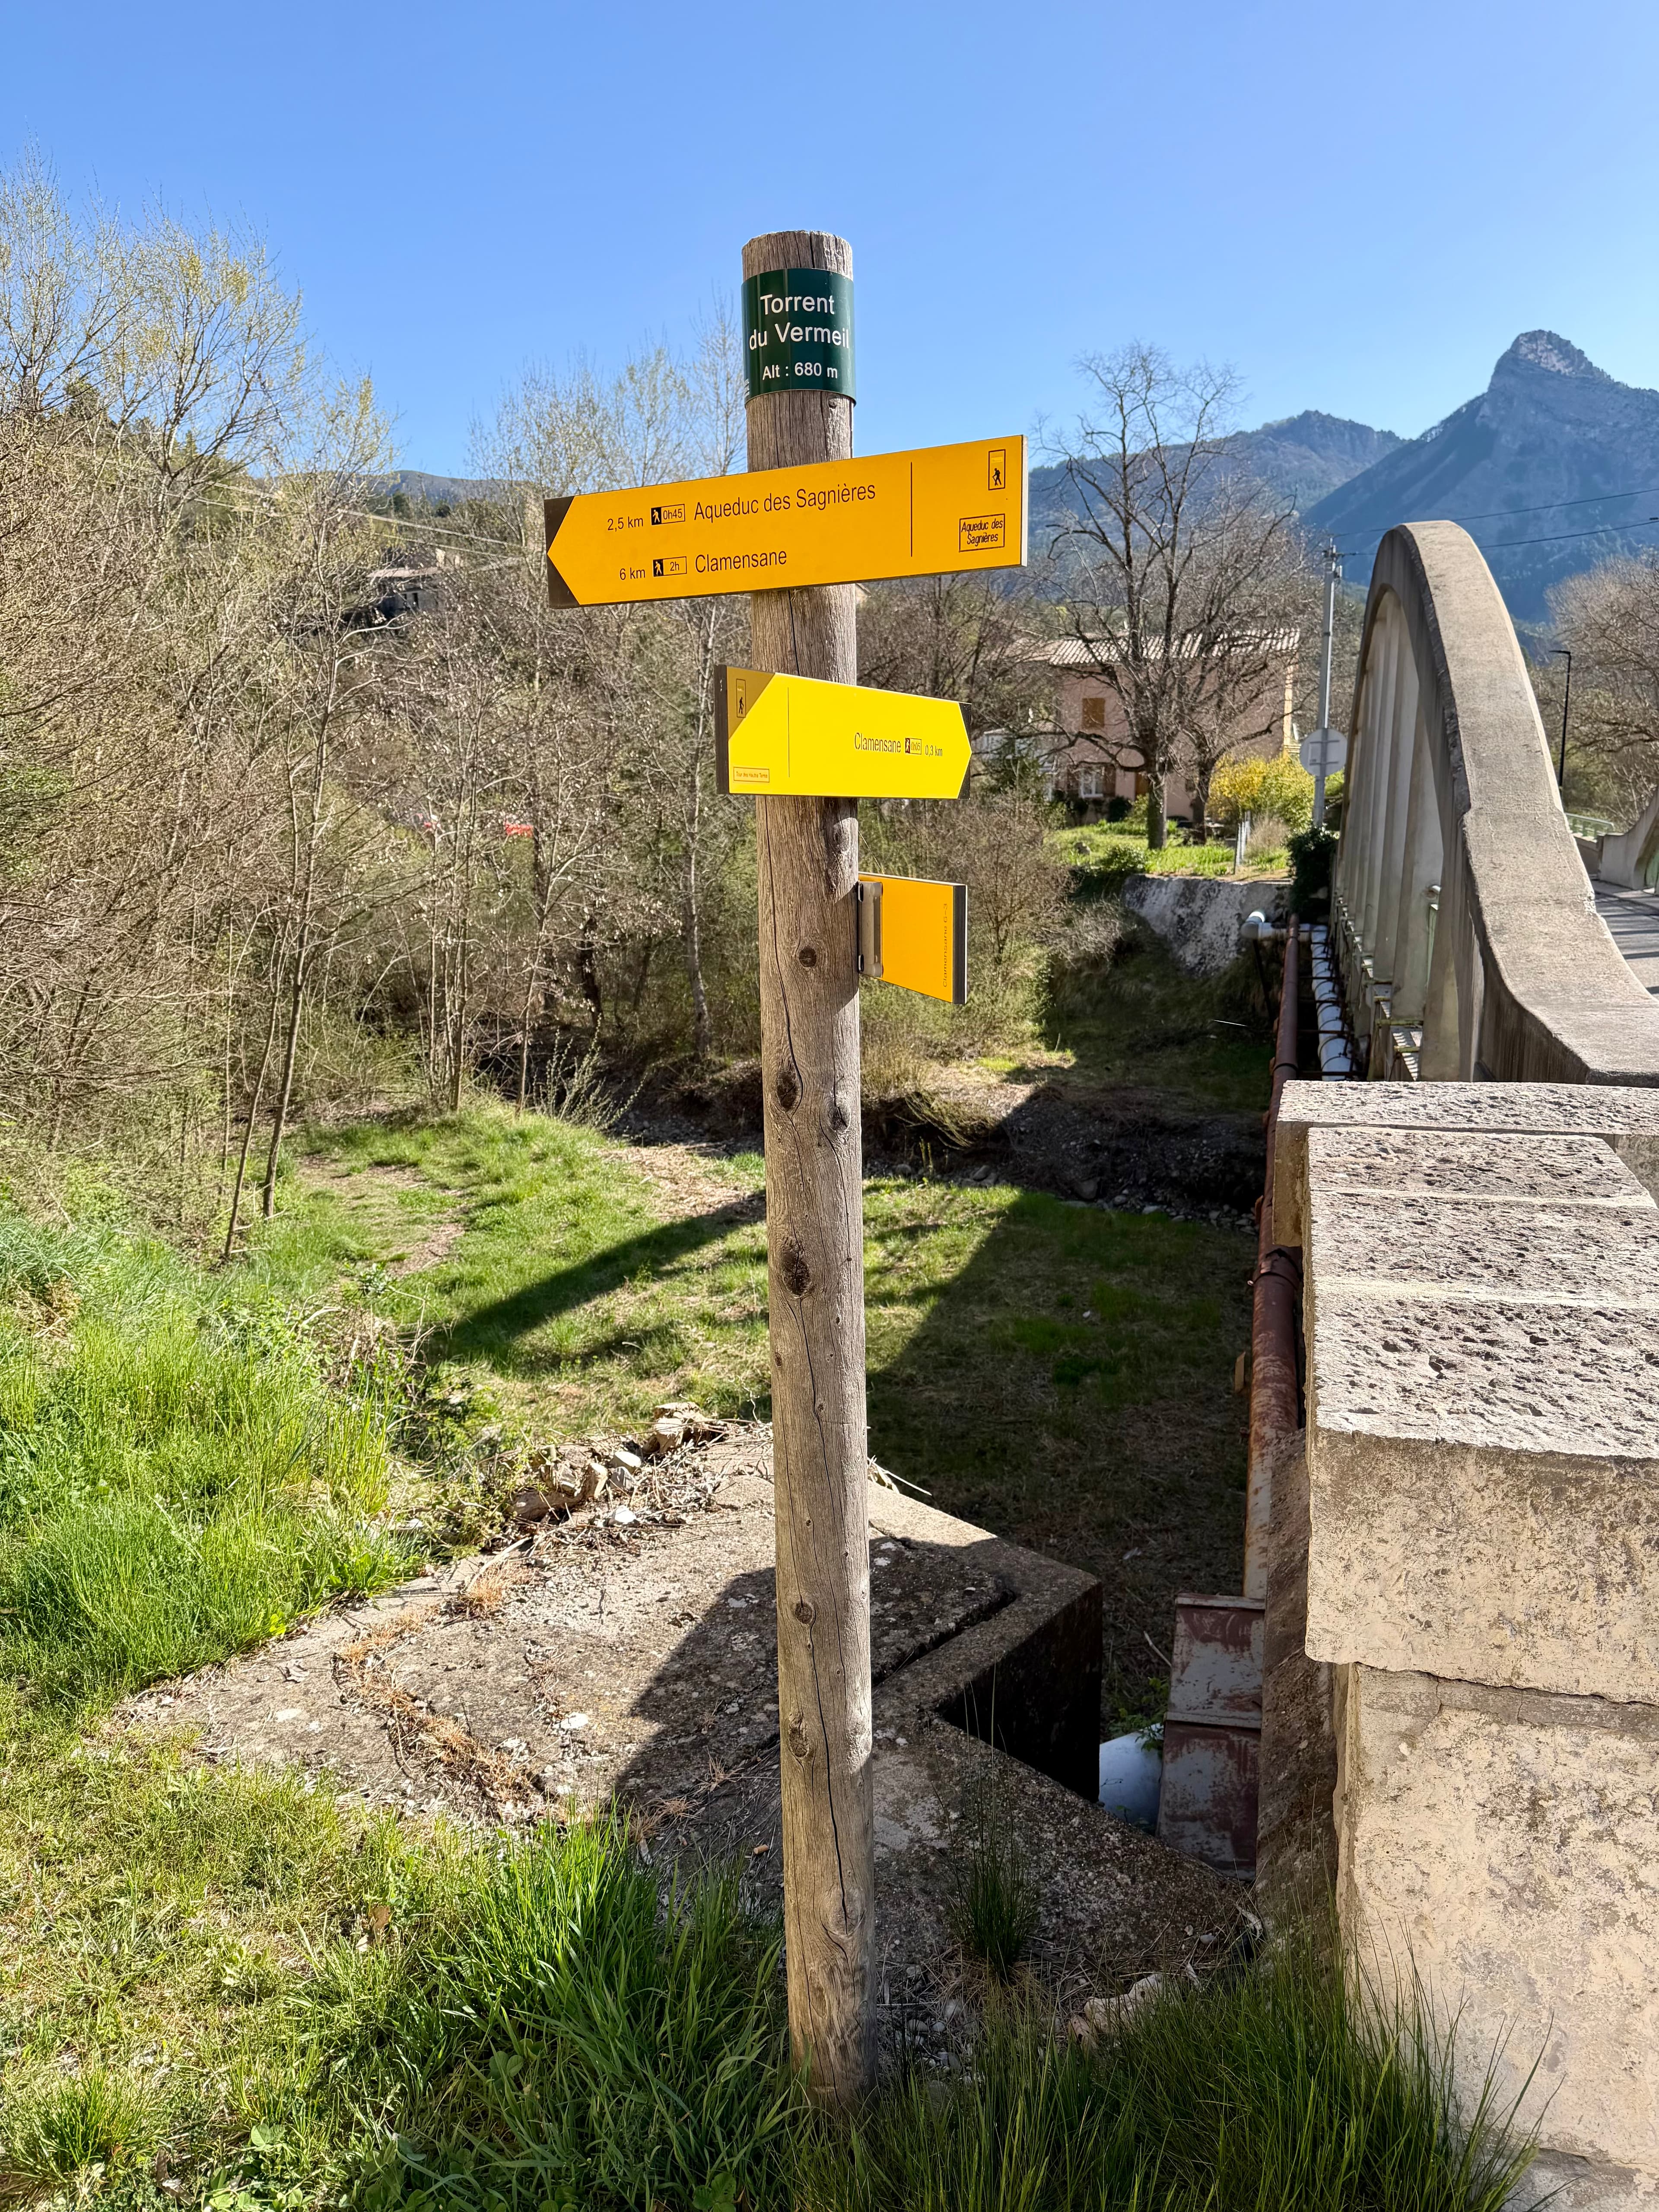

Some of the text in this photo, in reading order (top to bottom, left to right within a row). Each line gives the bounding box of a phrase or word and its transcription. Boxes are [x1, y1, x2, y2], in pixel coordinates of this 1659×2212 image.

[760, 294, 835, 315] Torrent
[749, 322, 849, 350] du Vermeil
[762, 365, 780, 380] Alt
[795, 362, 822, 376] 680
[827, 367, 838, 378] m
[607, 483, 876, 532] 2,5 km 0h45 Aqueduc des Sagnières
[961, 518, 1003, 535] Aqueduc des
[967, 532, 998, 547] Sagnières
[620, 550, 787, 580] 6 km 2h Clamensane
[855, 732, 901, 753] Clamensane
[935, 746, 943, 756] km
